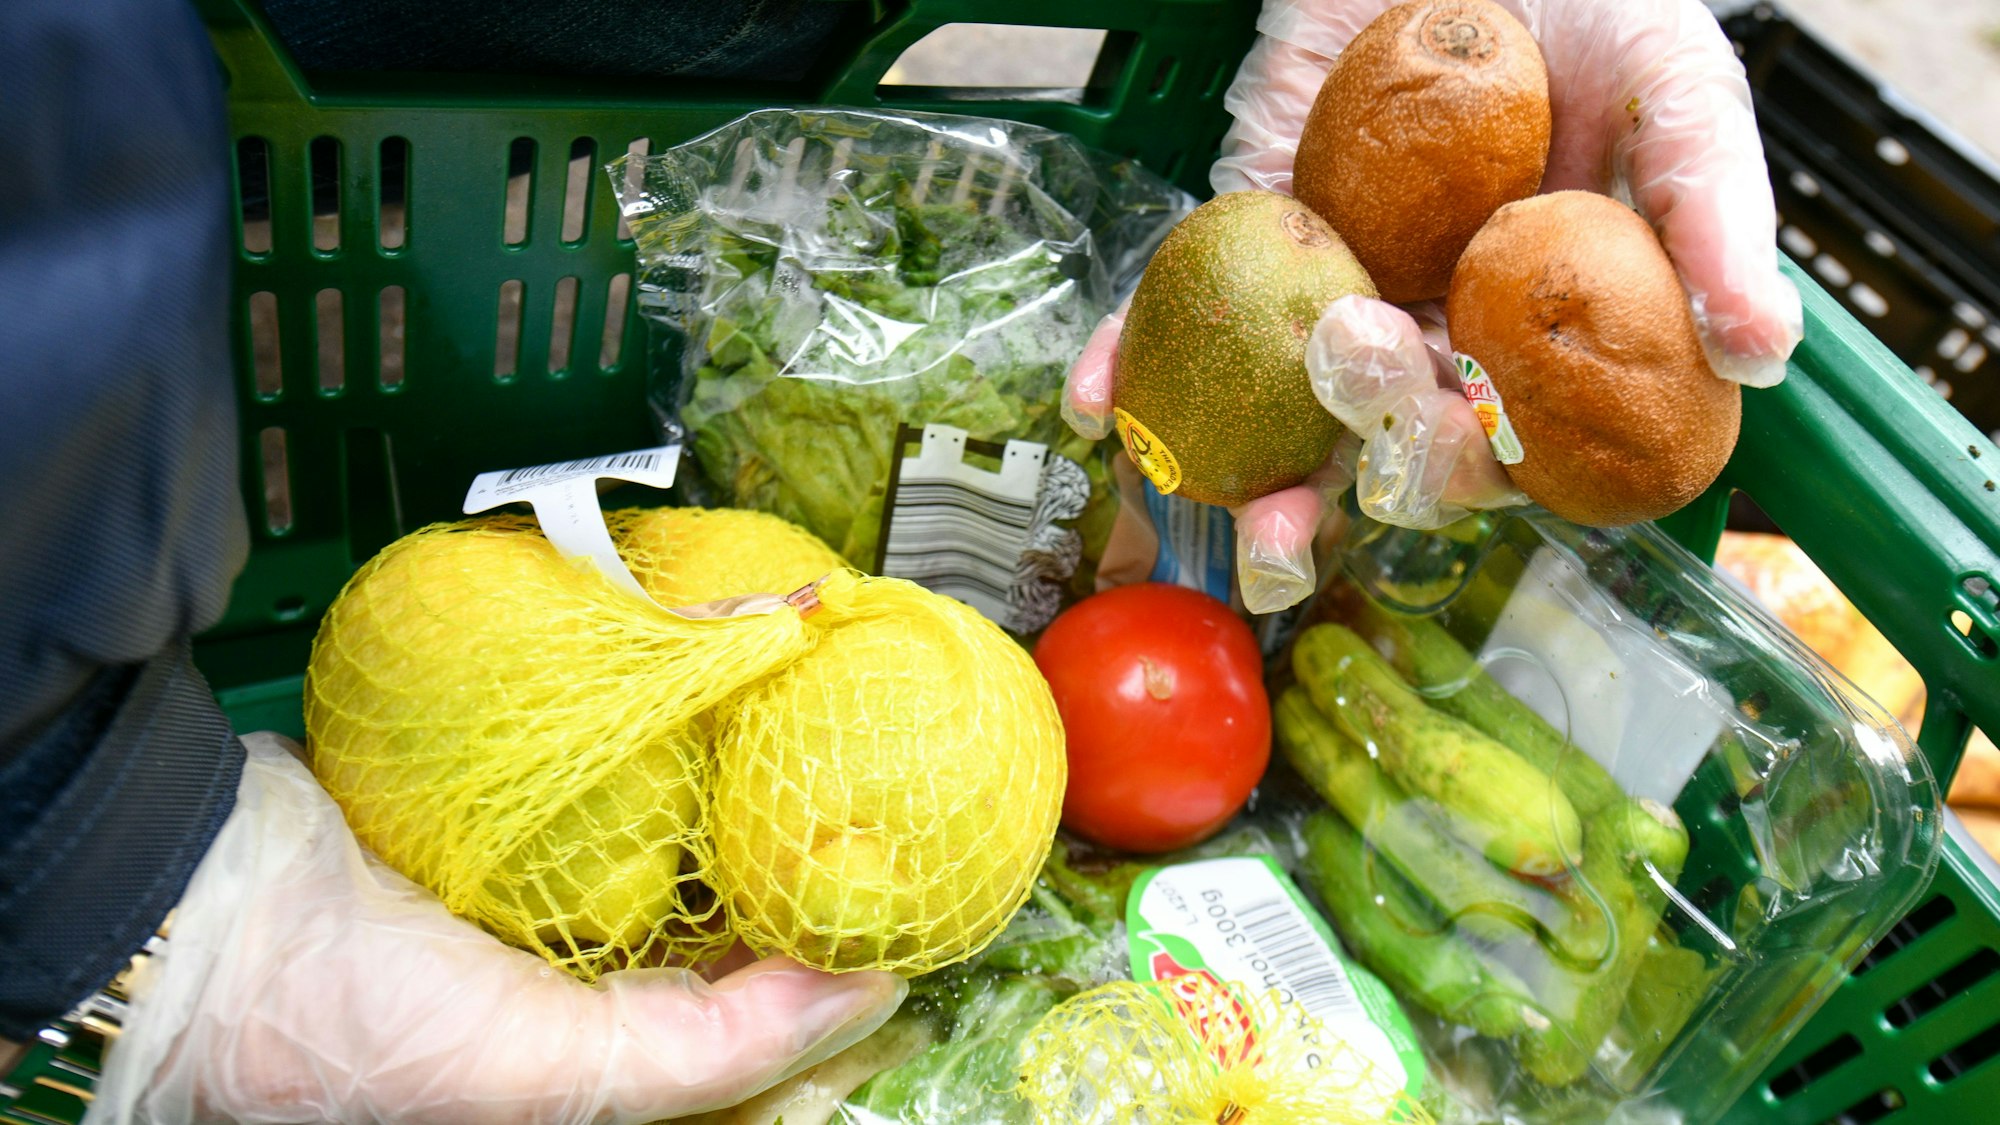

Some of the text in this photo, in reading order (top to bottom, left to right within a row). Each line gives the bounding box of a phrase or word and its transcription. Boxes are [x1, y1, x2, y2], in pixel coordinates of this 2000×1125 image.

[1159, 450, 1172, 463] THE
[1201, 889, 1246, 948] 300g
[1239, 952, 1294, 1006] Choi
